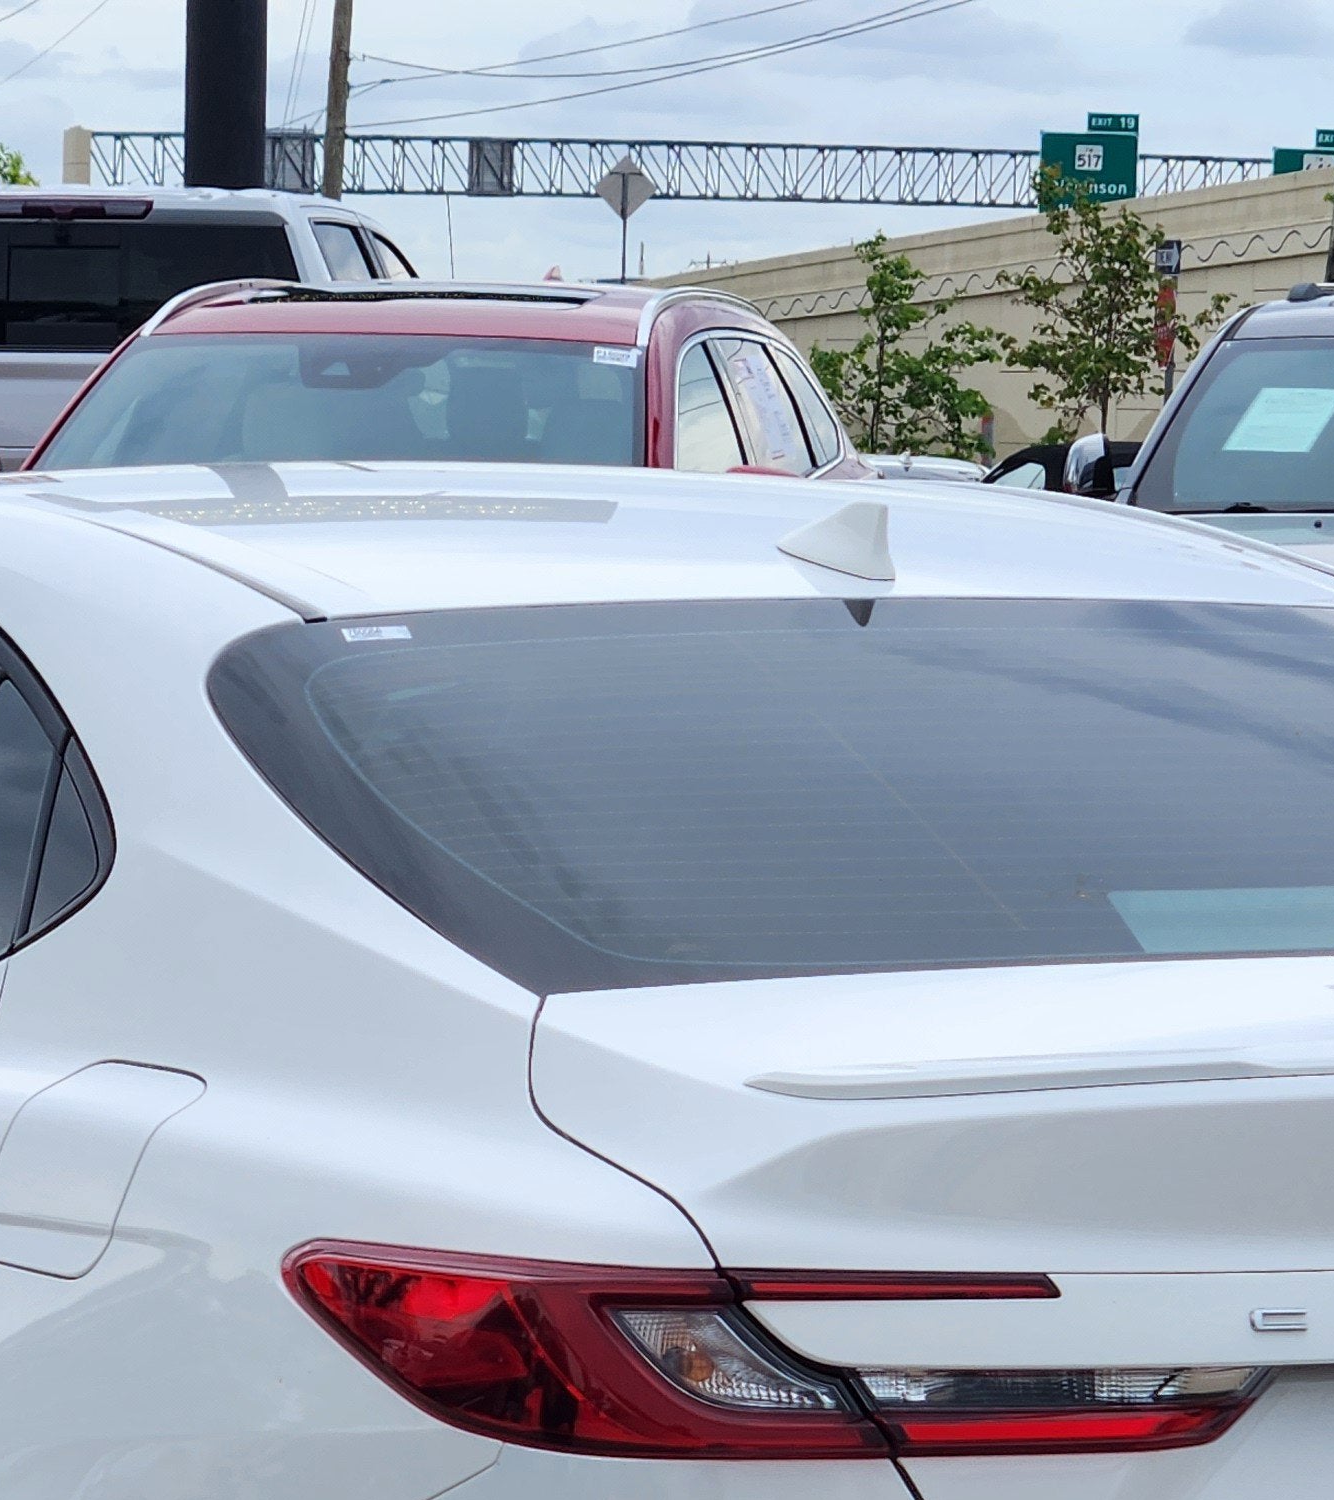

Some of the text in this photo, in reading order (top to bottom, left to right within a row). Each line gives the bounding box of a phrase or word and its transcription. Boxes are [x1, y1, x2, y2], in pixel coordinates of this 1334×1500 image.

[1091, 116, 1135, 129] EXIT 19
[1077, 154, 1101, 168] 517
